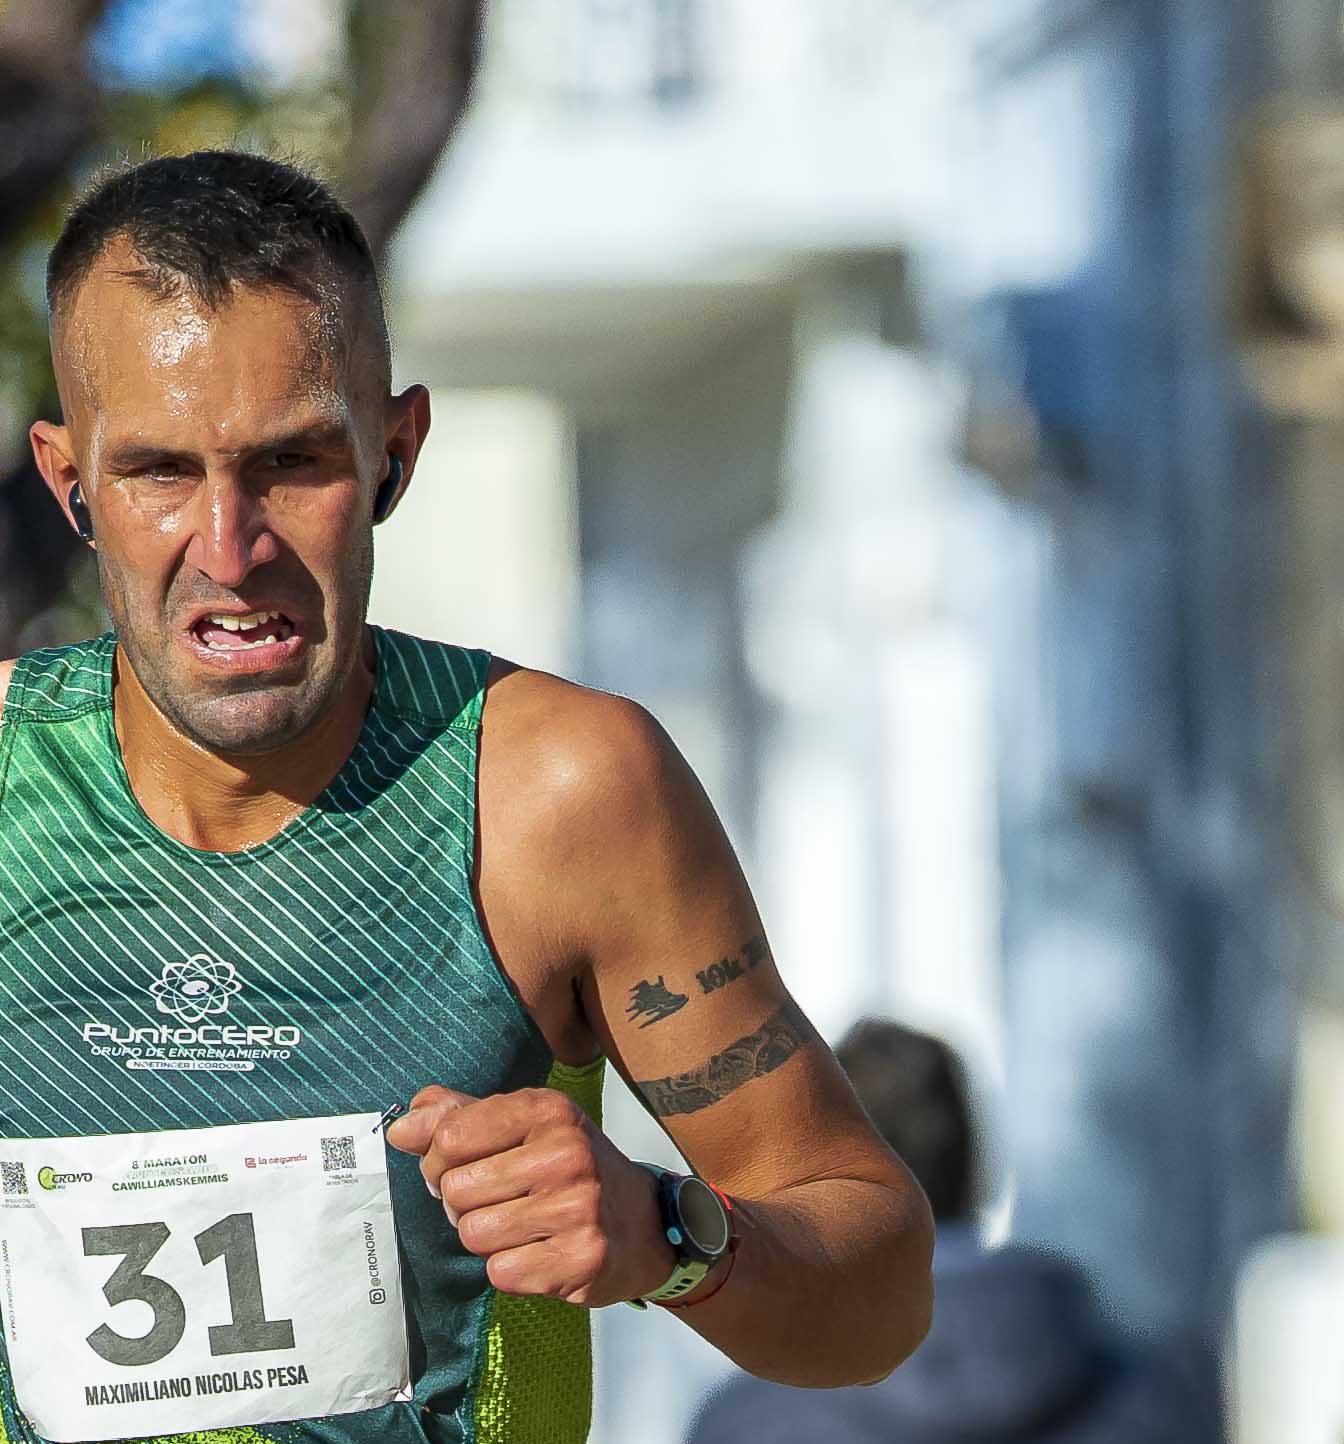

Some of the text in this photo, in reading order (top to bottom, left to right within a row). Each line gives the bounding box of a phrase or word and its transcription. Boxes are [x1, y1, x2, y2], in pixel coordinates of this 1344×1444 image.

[83, 1023, 301, 1046] PuntoCERO
[90, 1046, 291, 1060] GRUPO DE ENTRENAMIENTO
[144, 1154, 208, 1169] MARATON
[363, 1221, 381, 1286] @CRONORAV
[81, 1212, 296, 1367] 31
[84, 1364, 310, 1406] MAXIMILIANO NICOLAS PESA
